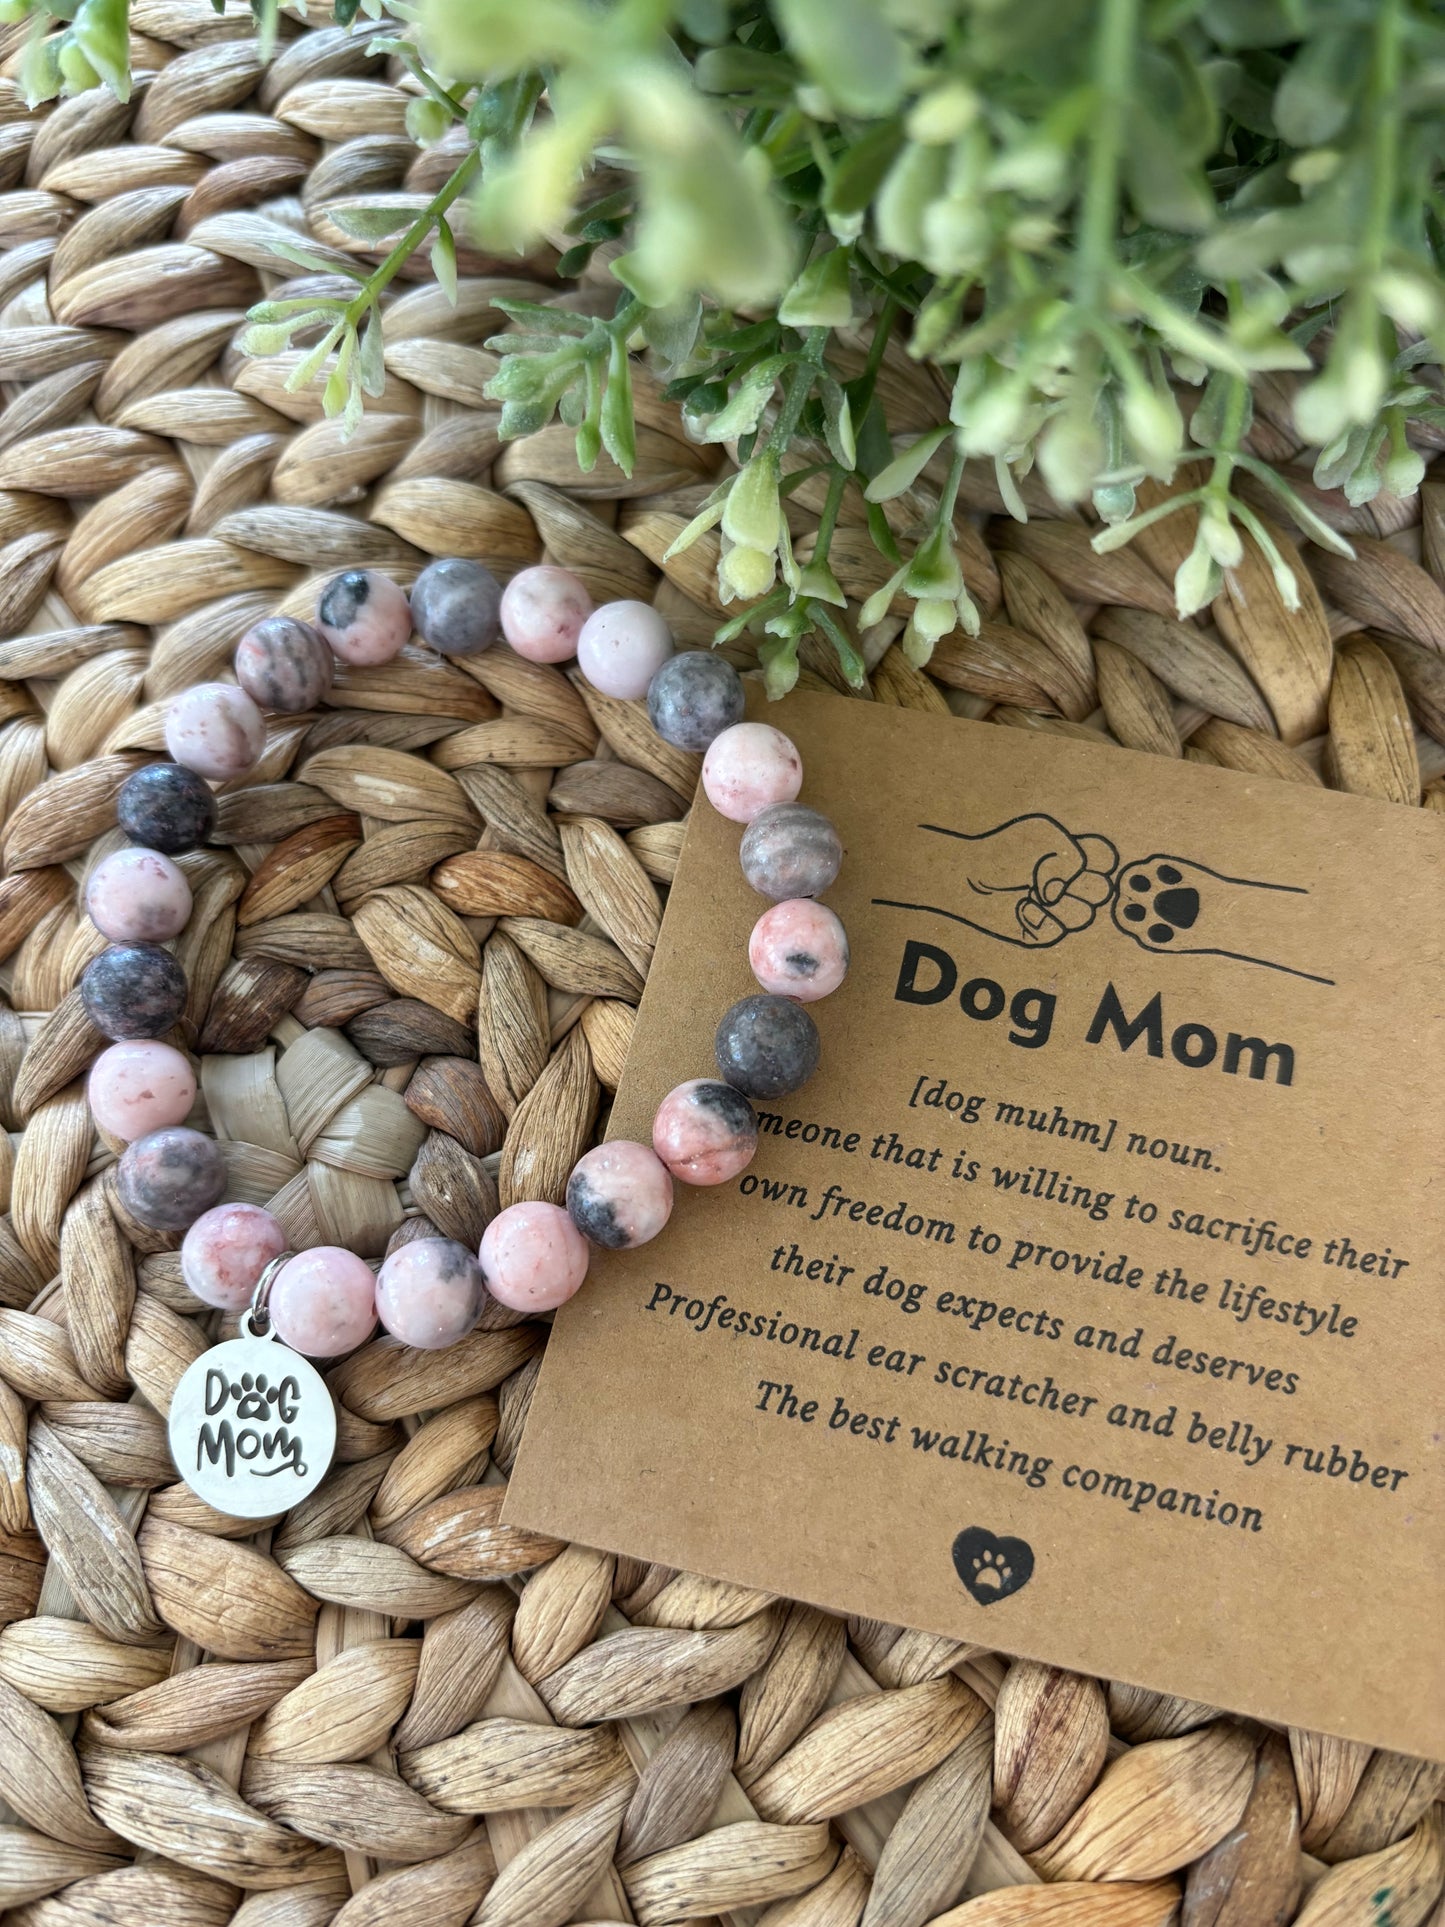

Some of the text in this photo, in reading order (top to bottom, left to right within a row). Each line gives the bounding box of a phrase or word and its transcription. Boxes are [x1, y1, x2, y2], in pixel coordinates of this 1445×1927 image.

[894, 939, 1294, 1086] Dog Mom
[757, 1111, 1409, 1278] meone that is willing to sacrifice their
[909, 1076, 1220, 1172] [dog muhm] noun.
[739, 1173, 1357, 1337] own freedom to provide the lifestyle
[771, 1244, 1299, 1394] their dog expects and deserves
[645, 1282, 1408, 1490] Professional ear scratcher and belly rubber
[756, 1380, 1262, 1532] The best walking companion
